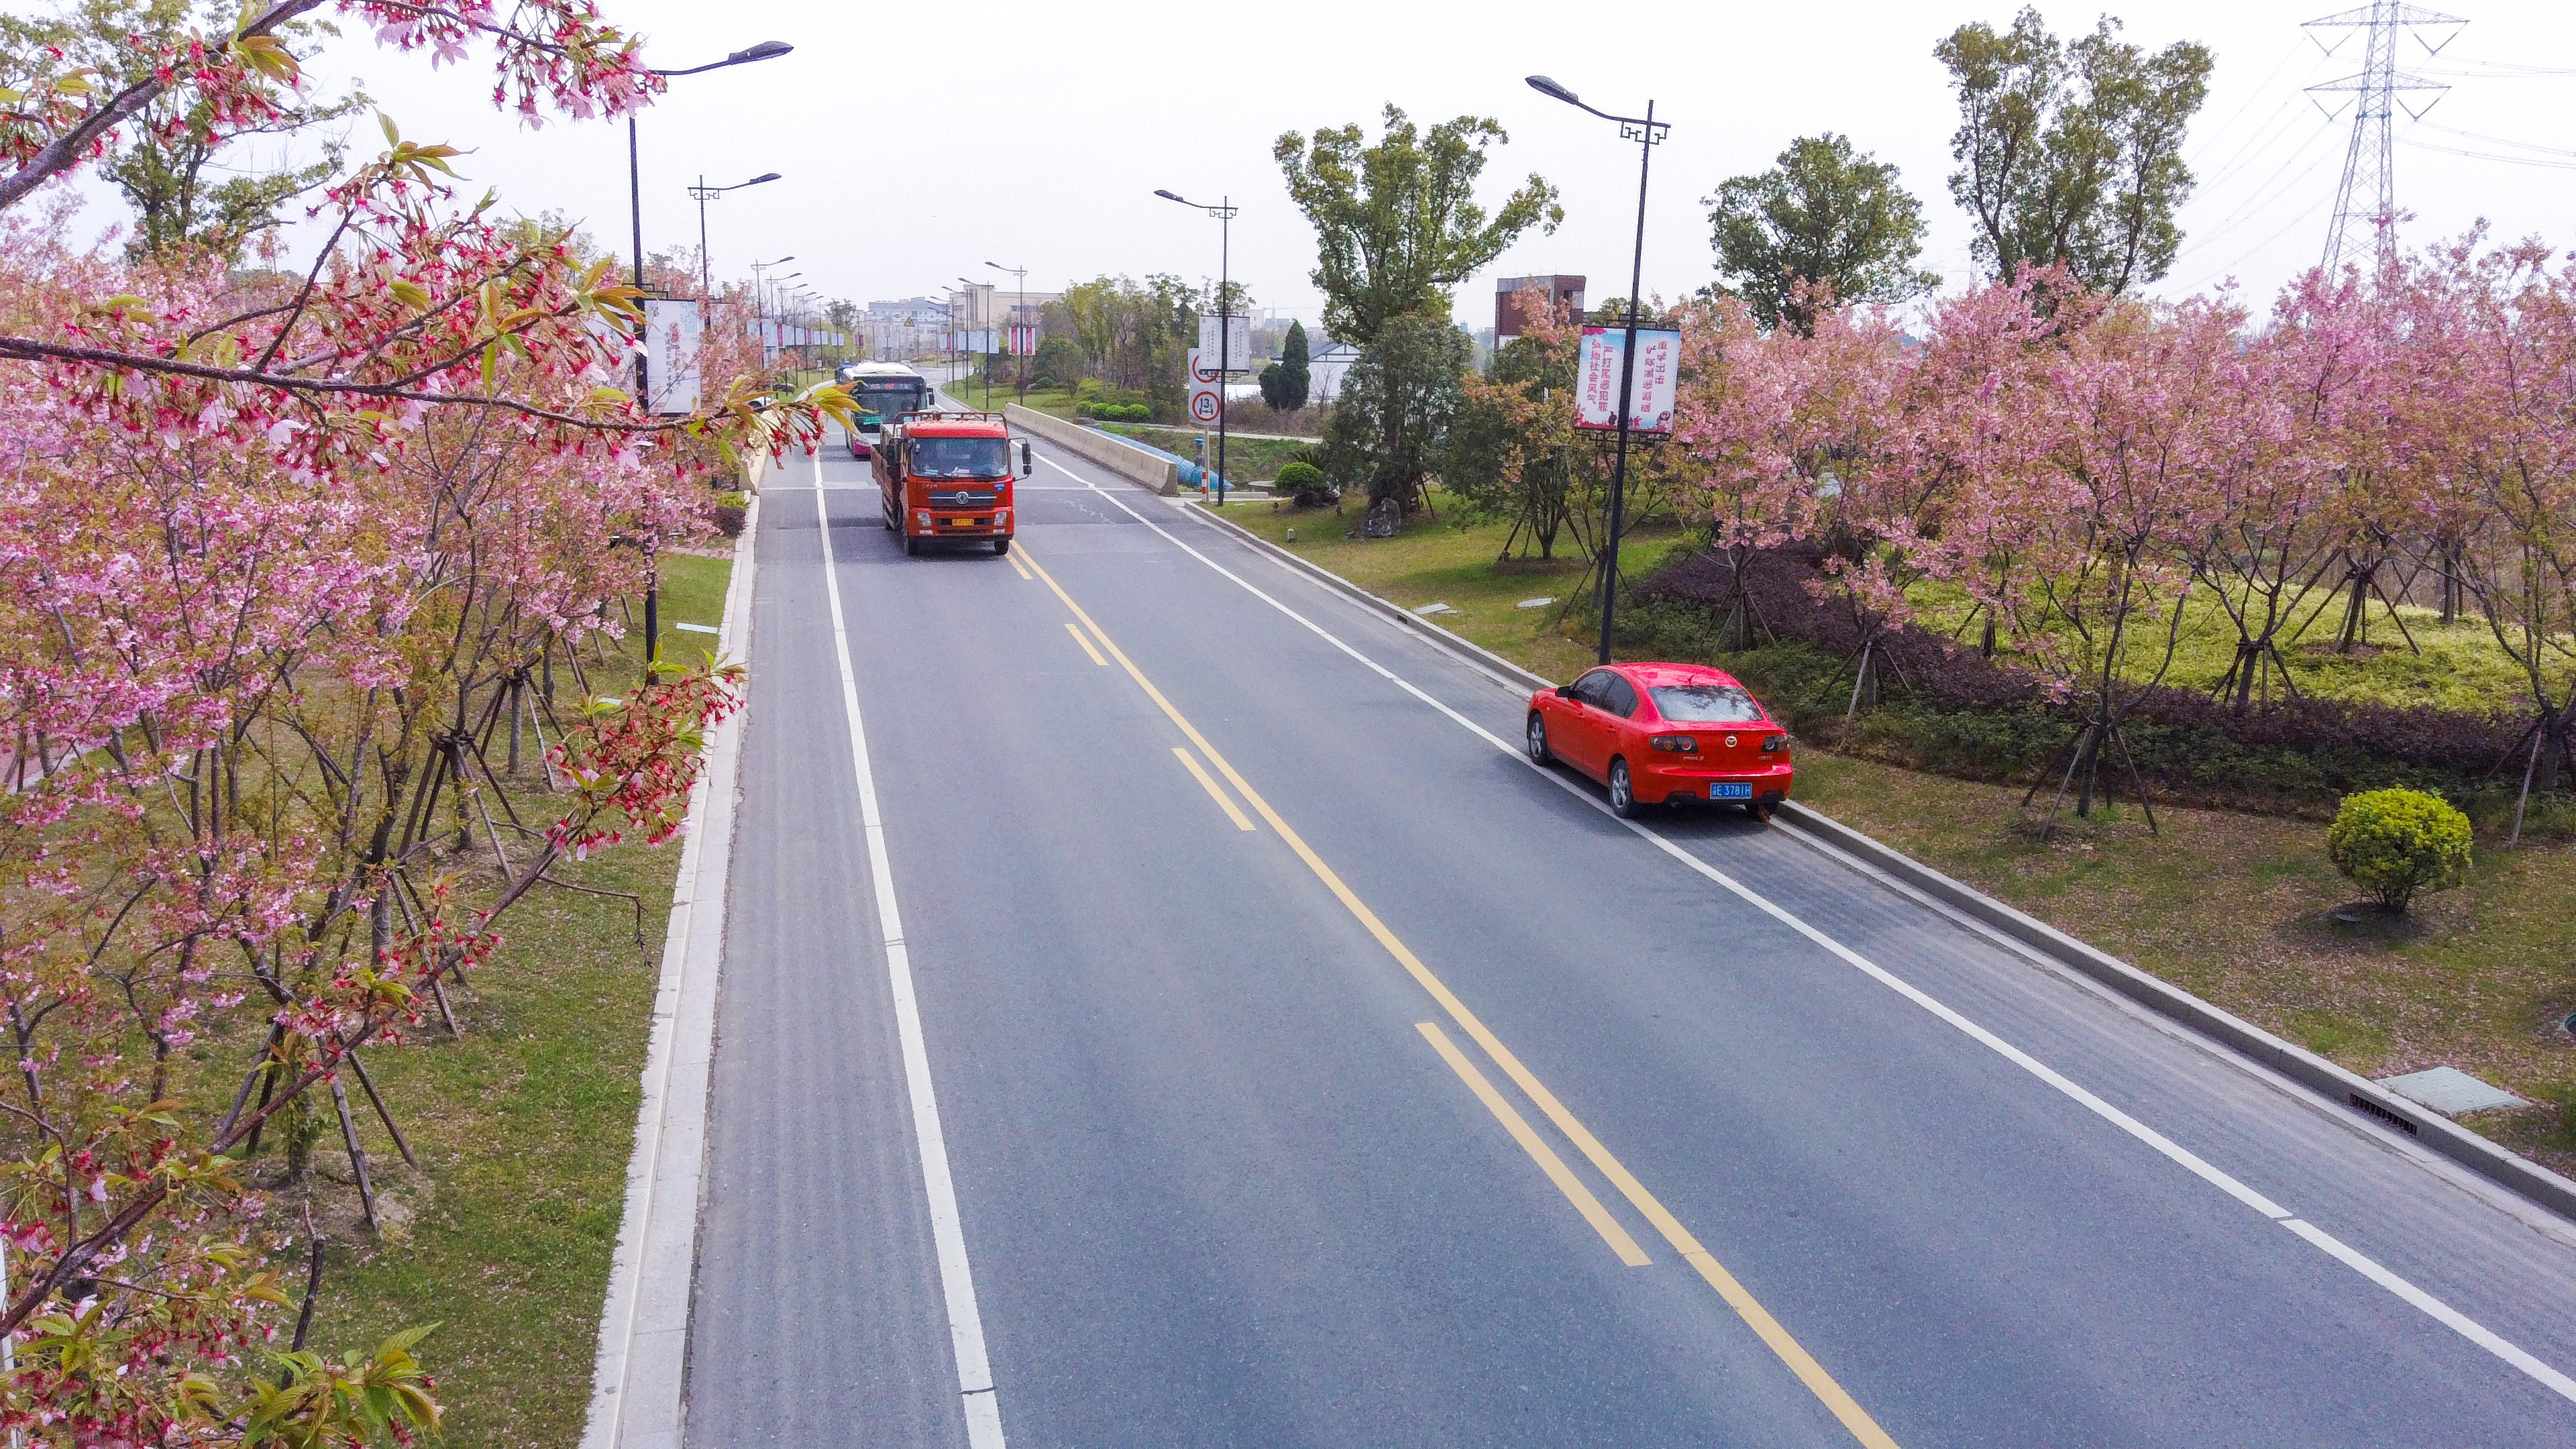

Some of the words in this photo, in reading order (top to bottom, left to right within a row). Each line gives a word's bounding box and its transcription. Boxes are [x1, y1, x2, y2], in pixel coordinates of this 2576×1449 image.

[1587, 338, 1601, 405] 弘扬社会风气
[1598, 345, 1614, 413] 严打黑恶犯罪
